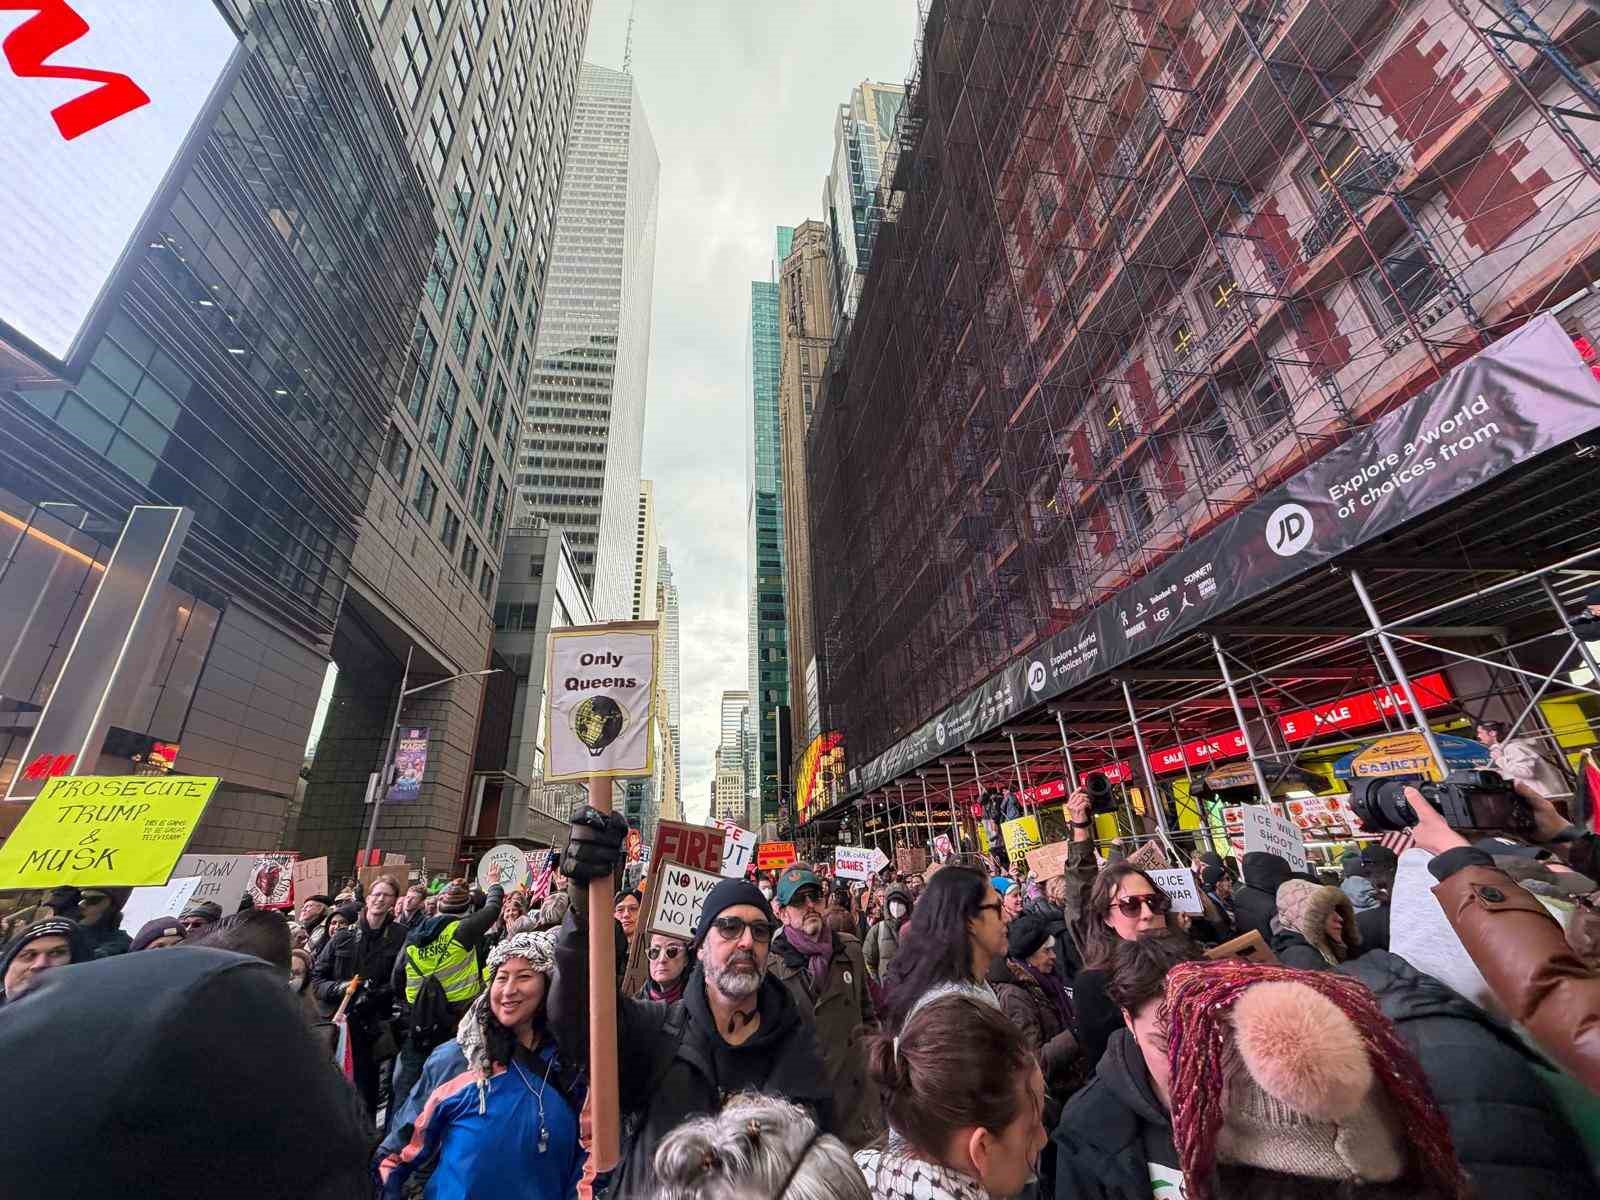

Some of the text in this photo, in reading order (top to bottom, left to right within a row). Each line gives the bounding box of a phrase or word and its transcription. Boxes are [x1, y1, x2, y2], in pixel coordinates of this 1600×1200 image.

[1328, 395, 1490, 501] Explore a world
[1337, 420, 1501, 519] of choices from
[1276, 511, 1305, 550] JD
[1153, 607, 1170, 622] UGG
[1050, 649, 1073, 667] Explore
[1078, 631, 1097, 651] world
[580, 651, 624, 668] Only
[1059, 656, 1083, 674] choices
[1082, 647, 1098, 662] from
[564, 676, 637, 691] Queens
[1373, 692, 1408, 711] SAL
[1314, 707, 1351, 726] SALE
[1196, 742, 1220, 757] SALE
[48, 780, 207, 799] PROSECUTE
[57, 803, 151, 824] TRUMP
[1253, 813, 1298, 840] ICE WILL
[78, 828, 102, 846] &
[1259, 829, 1293, 849] SHOOT
[653, 825, 723, 873] FIRE
[1264, 843, 1304, 868] YOU TOO
[17, 847, 120, 874] MUSK
[193, 858, 238, 877] DOWN
[192, 882, 223, 896] ITH
[667, 870, 717, 892] NO WA
[1167, 875, 1185, 886] ICE
[663, 891, 687, 906] NO
[660, 908, 685, 925] NO
